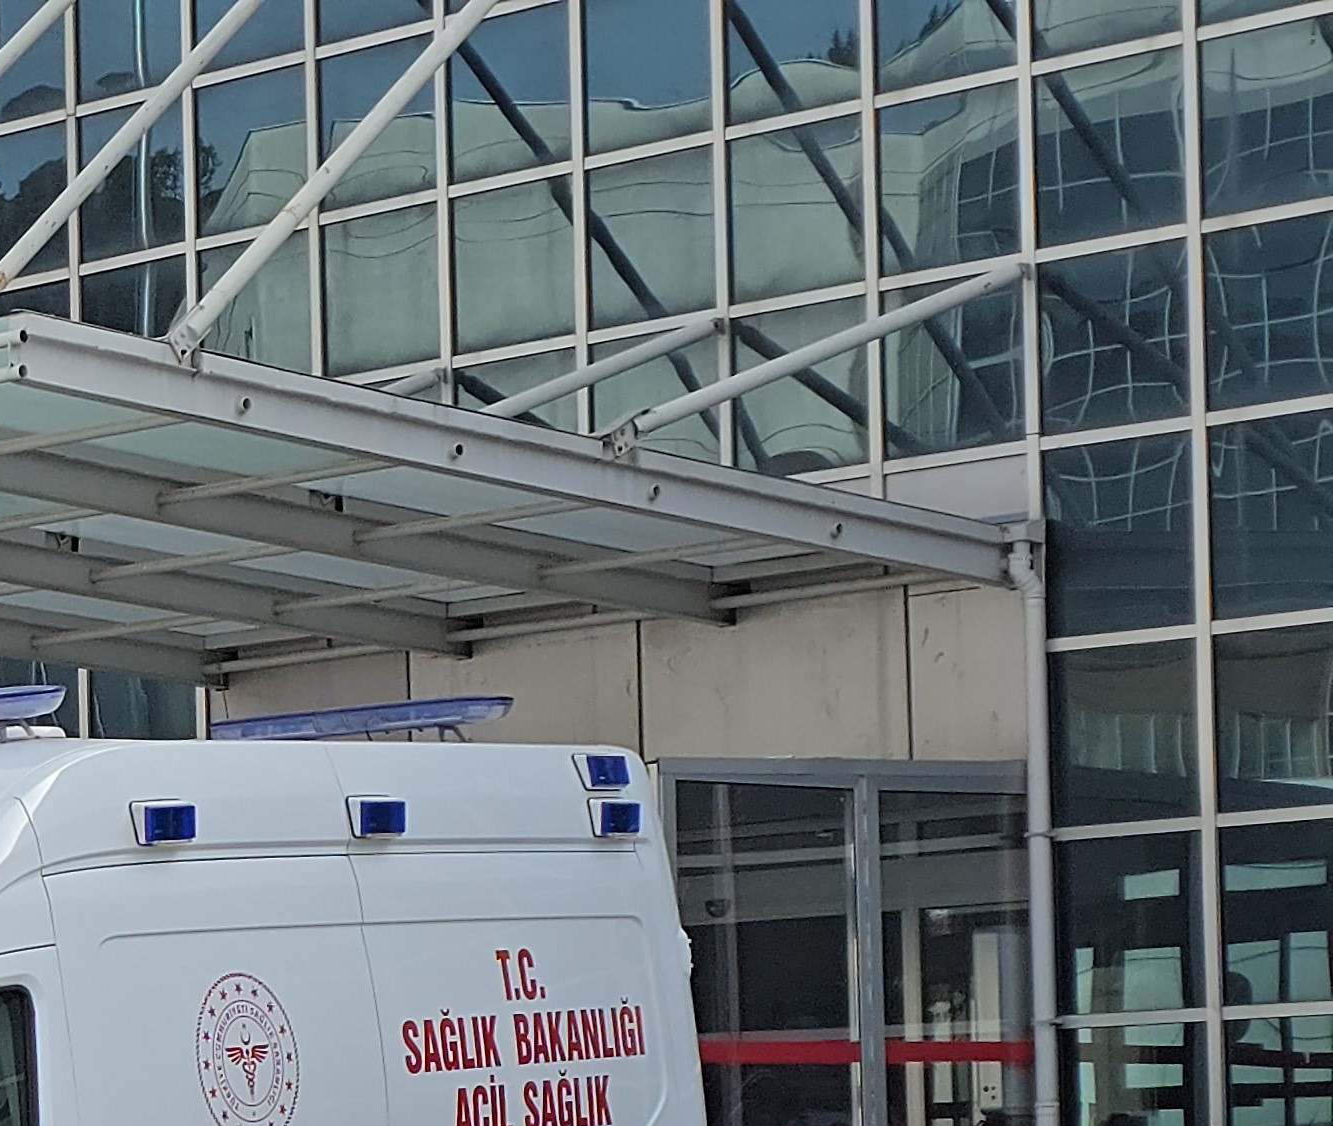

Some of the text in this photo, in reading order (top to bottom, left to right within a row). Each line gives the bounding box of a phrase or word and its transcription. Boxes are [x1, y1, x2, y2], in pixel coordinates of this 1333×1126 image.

[495, 948, 546, 1001] T.C.
[402, 996, 646, 1074] SAĞLIK BAKANLIĞI
